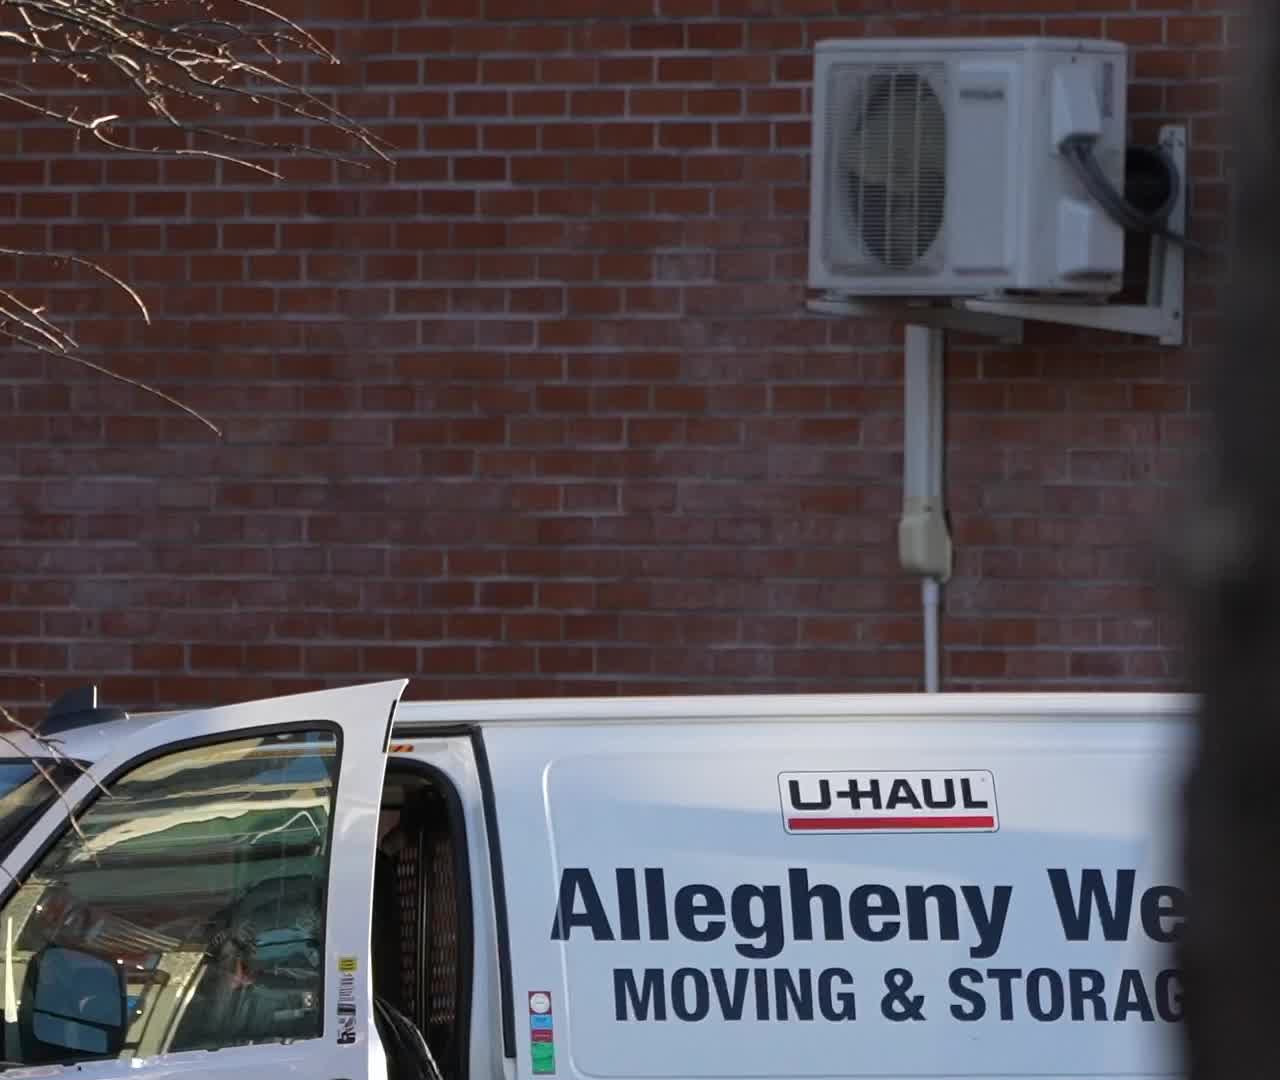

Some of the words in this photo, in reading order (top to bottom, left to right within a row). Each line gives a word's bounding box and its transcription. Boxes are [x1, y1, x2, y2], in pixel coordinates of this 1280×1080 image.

[788, 777, 989, 811] U-HAUL
[550, 867, 1013, 959] Allegheny
[1047, 868, 1188, 943] We
[613, 967, 857, 1022] MOVING
[880, 967, 926, 1022] &
[948, 967, 1187, 1023] STORAG
